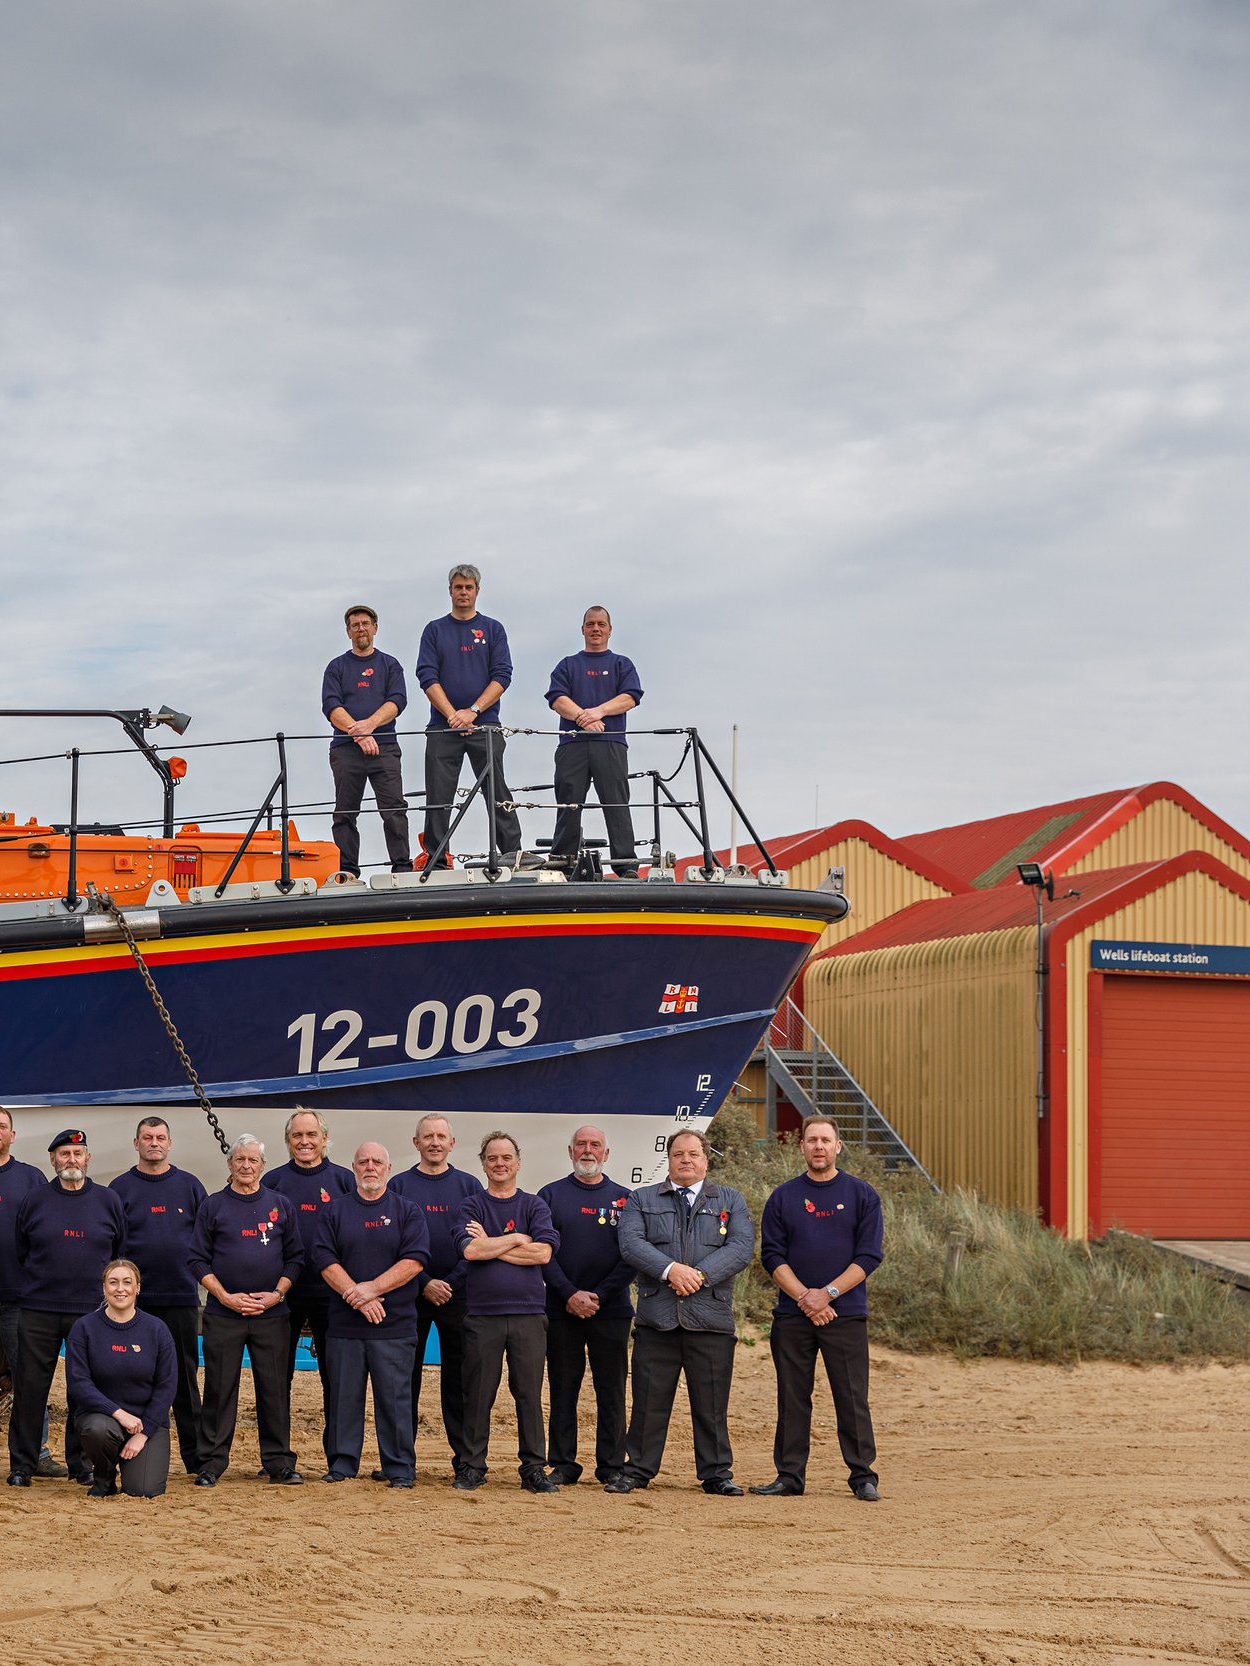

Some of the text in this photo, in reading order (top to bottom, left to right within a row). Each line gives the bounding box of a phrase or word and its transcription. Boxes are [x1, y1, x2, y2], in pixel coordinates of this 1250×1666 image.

[1099, 948, 1209, 965] Wells lifeboat station
[287, 988, 542, 1075] 12-003
[696, 1074, 712, 1092] 12
[674, 1105, 691, 1122] 10
[654, 1135, 667, 1153] 8
[631, 1167, 643, 1184] 6
[150, 1205, 167, 1214] RNLI
[300, 1203, 317, 1212] RNLI
[425, 1204, 449, 1213] RNLI
[580, 1206, 598, 1216] RNLI
[815, 1210, 835, 1218] RNLI
[364, 1220, 383, 1229] RNLI
[63, 1229, 85, 1238] RNLI
[241, 1229, 258, 1237] RNLI
[111, 1344, 128, 1353] RNLI
